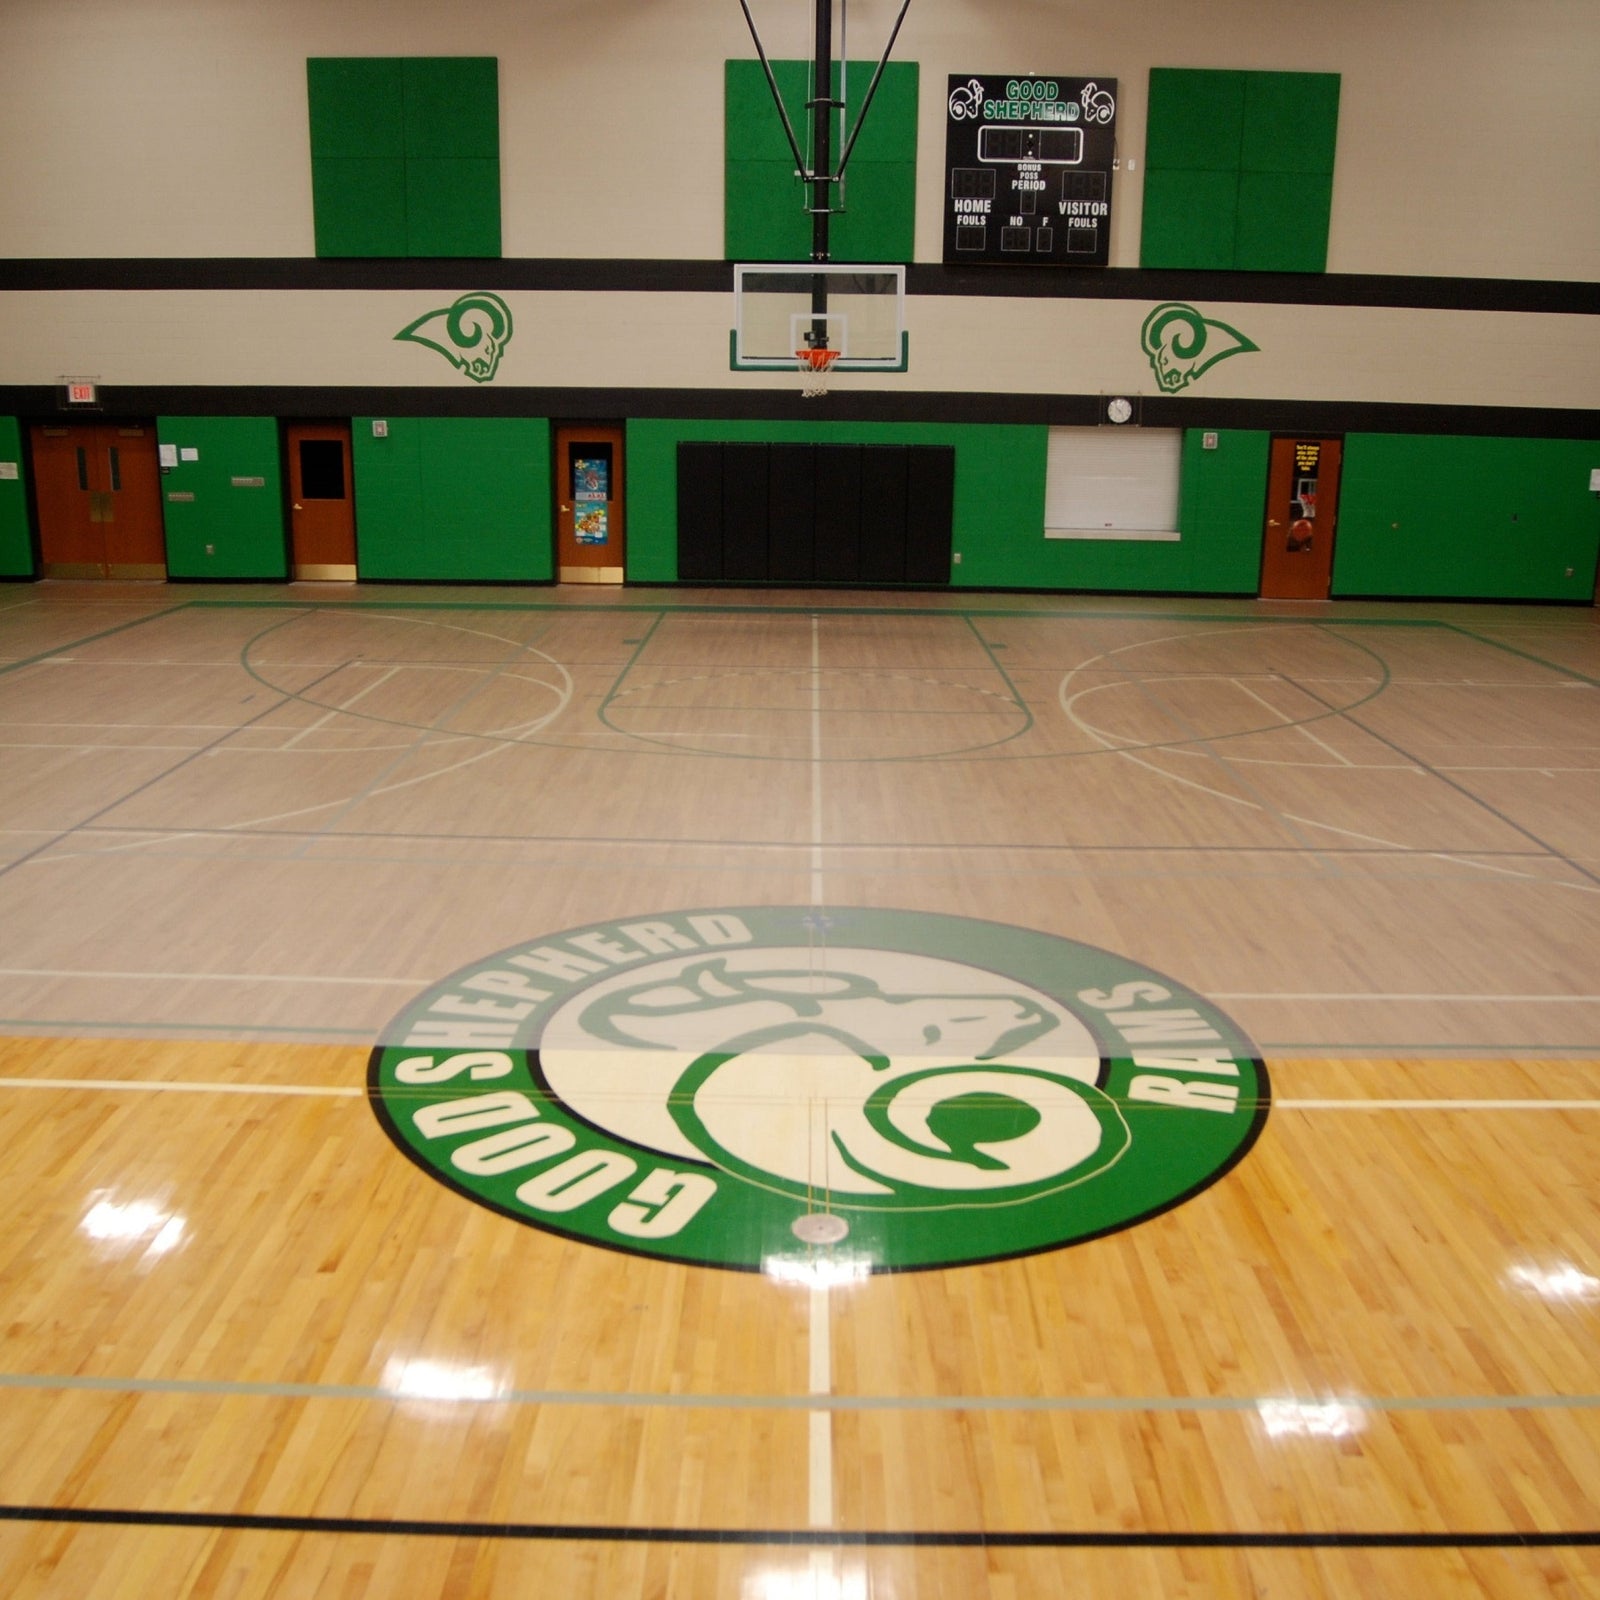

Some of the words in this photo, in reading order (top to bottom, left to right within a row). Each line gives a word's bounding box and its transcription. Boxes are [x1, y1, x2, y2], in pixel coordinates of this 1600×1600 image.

[1006, 79, 1059, 100] GOOD
[983, 99, 1080, 121] SHEPHERD
[1017, 163, 1042, 171] BONUS
[1020, 171, 1039, 180] POSS
[1011, 180, 1046, 191] PERIOD
[954, 199, 991, 213] HOME
[1059, 202, 1108, 216] VISITOR
[957, 215, 986, 226] FOULS
[1010, 216, 1023, 226] NO
[1042, 216, 1049, 227] F
[1068, 217, 1098, 228] FOULS
[73, 386, 90, 399] EXIT
[394, 913, 753, 1085] SHEPHERD
[1077, 980, 1241, 1114] RAMS
[412, 1090, 718, 1239] GOOD
